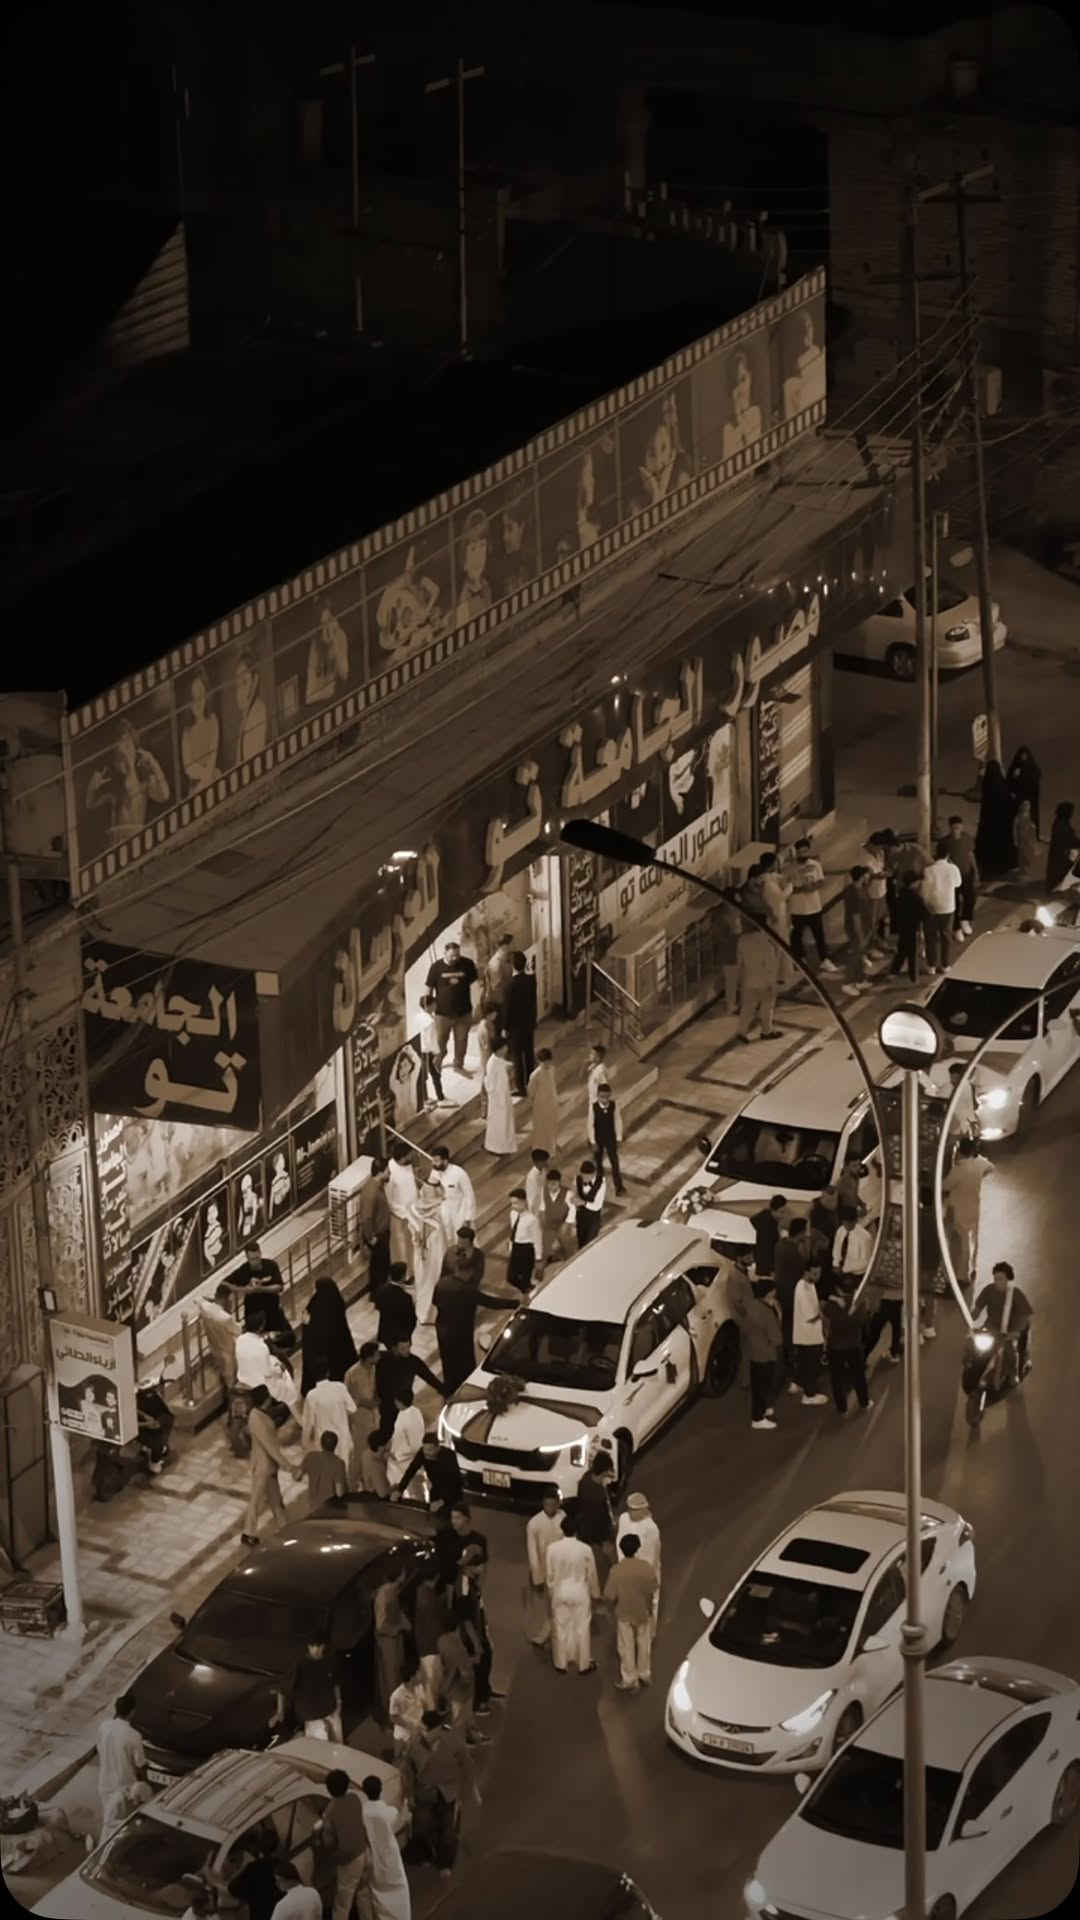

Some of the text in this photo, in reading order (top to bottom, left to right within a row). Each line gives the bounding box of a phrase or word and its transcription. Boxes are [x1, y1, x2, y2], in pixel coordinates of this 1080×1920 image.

[720, 594, 820, 716] مصور
[560, 656, 704, 808] الجامعة
[483, 760, 543, 894] تو
[691, 809, 729, 864] مصور
[620, 877, 635, 917] تو
[80, 958, 238, 1046] الجامعة
[132, 1050, 247, 1118] تو
